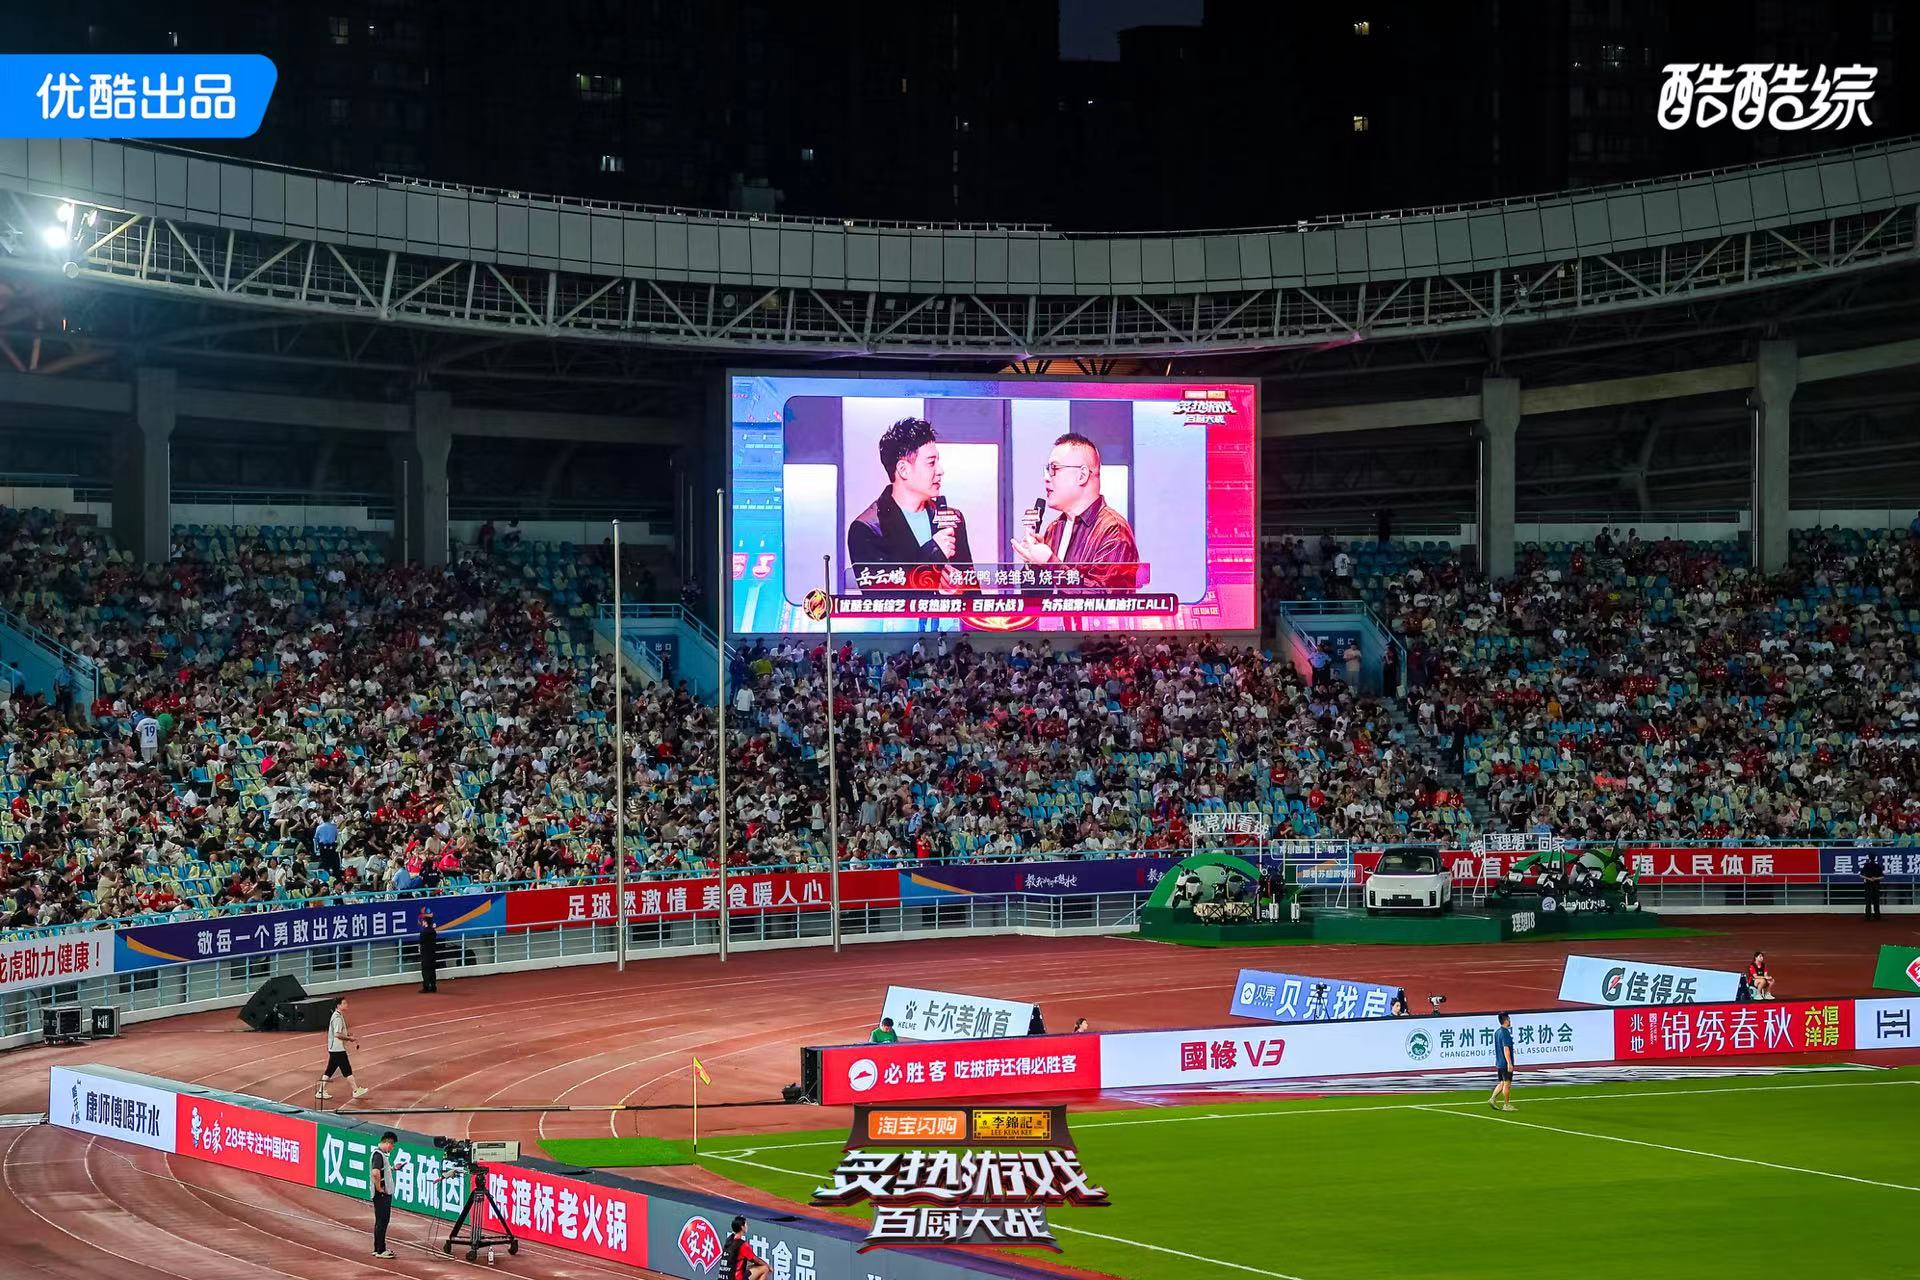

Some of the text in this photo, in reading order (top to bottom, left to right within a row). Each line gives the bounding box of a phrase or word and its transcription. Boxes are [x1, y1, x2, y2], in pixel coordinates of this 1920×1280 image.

[856, 567, 907, 587] 岳云鹏
[950, 570, 1081, 586] 烧花鸭 烧雏鸡 烧子鹅
[144, 726, 155, 737] 19
[1619, 854, 1774, 876] 强人民体质
[702, 879, 823, 911] 美食暖人心
[197, 911, 407, 955] 敬每一个勇敢出发的自己
[1276, 979, 1387, 1020] 贝壳找房
[1626, 971, 1697, 1004] 佳得乐
[898, 1021, 917, 1030] KELME
[922, 1000, 1011, 1038] 卡尔美体育
[1440, 1023, 1573, 1048] 常州市球协会
[1630, 1014, 1645, 1054] 兆地
[1661, 1007, 1795, 1053] 锦绣春秋
[1181, 1039, 1286, 1071] 國緣 V3
[1440, 1049, 1486, 1058] CHANGZHOU
[1526, 1045, 1574, 1054] ASSOCIATION
[884, 1055, 1076, 1085] 必胜客 吃披萨还得必胜客
[86, 1091, 160, 1136] 康师傅喝开水
[202, 1120, 222, 1155] 白象
[225, 1126, 300, 1164] 28年专注中国好面
[322, 1132, 465, 1214] 仅三角硫因
[489, 1172, 627, 1252] 陈渡桥老火锅
